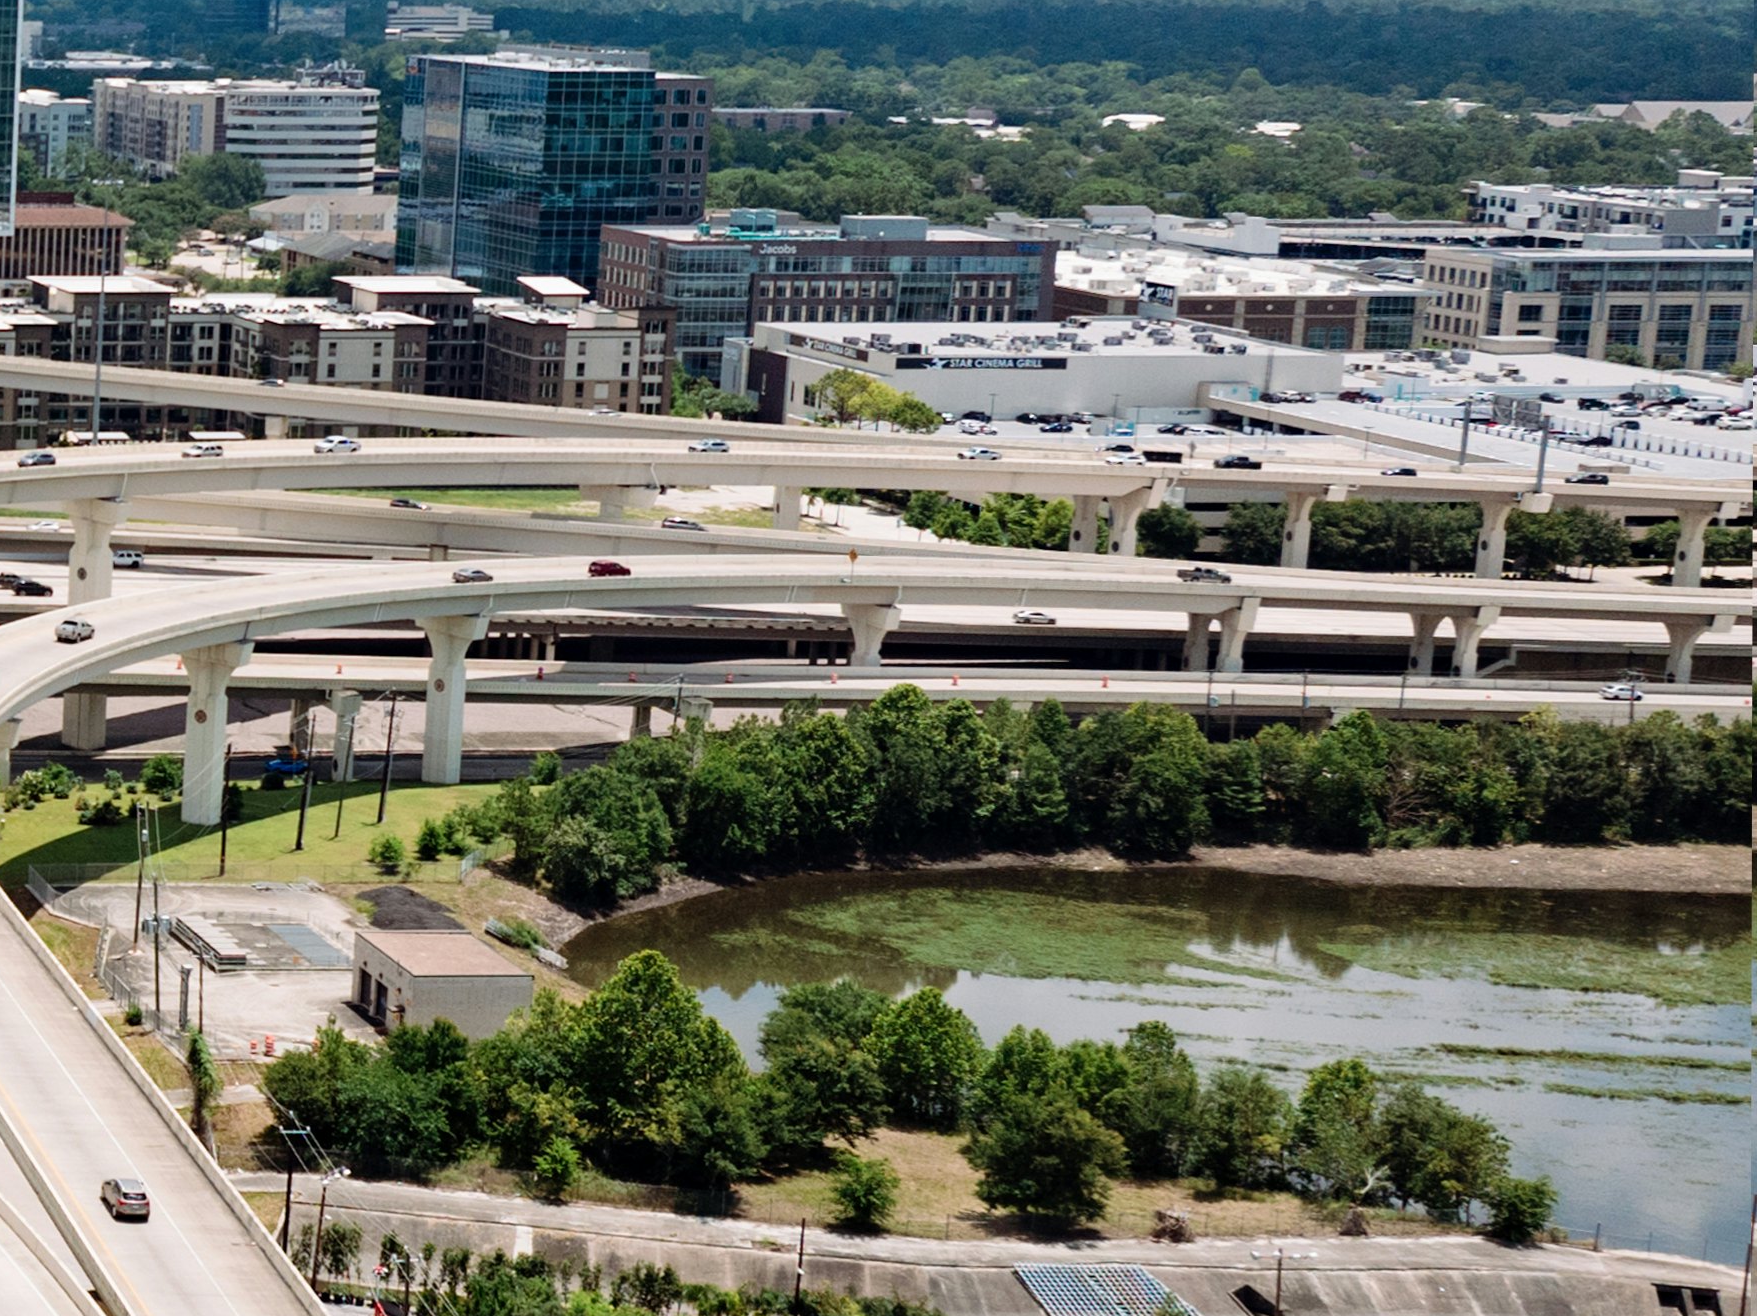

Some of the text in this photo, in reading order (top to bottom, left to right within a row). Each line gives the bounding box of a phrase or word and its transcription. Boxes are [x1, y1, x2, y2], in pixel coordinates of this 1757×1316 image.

[759, 243, 797, 255] Jacobs
[949, 358, 1043, 369] STAR CINEMA GRILL
